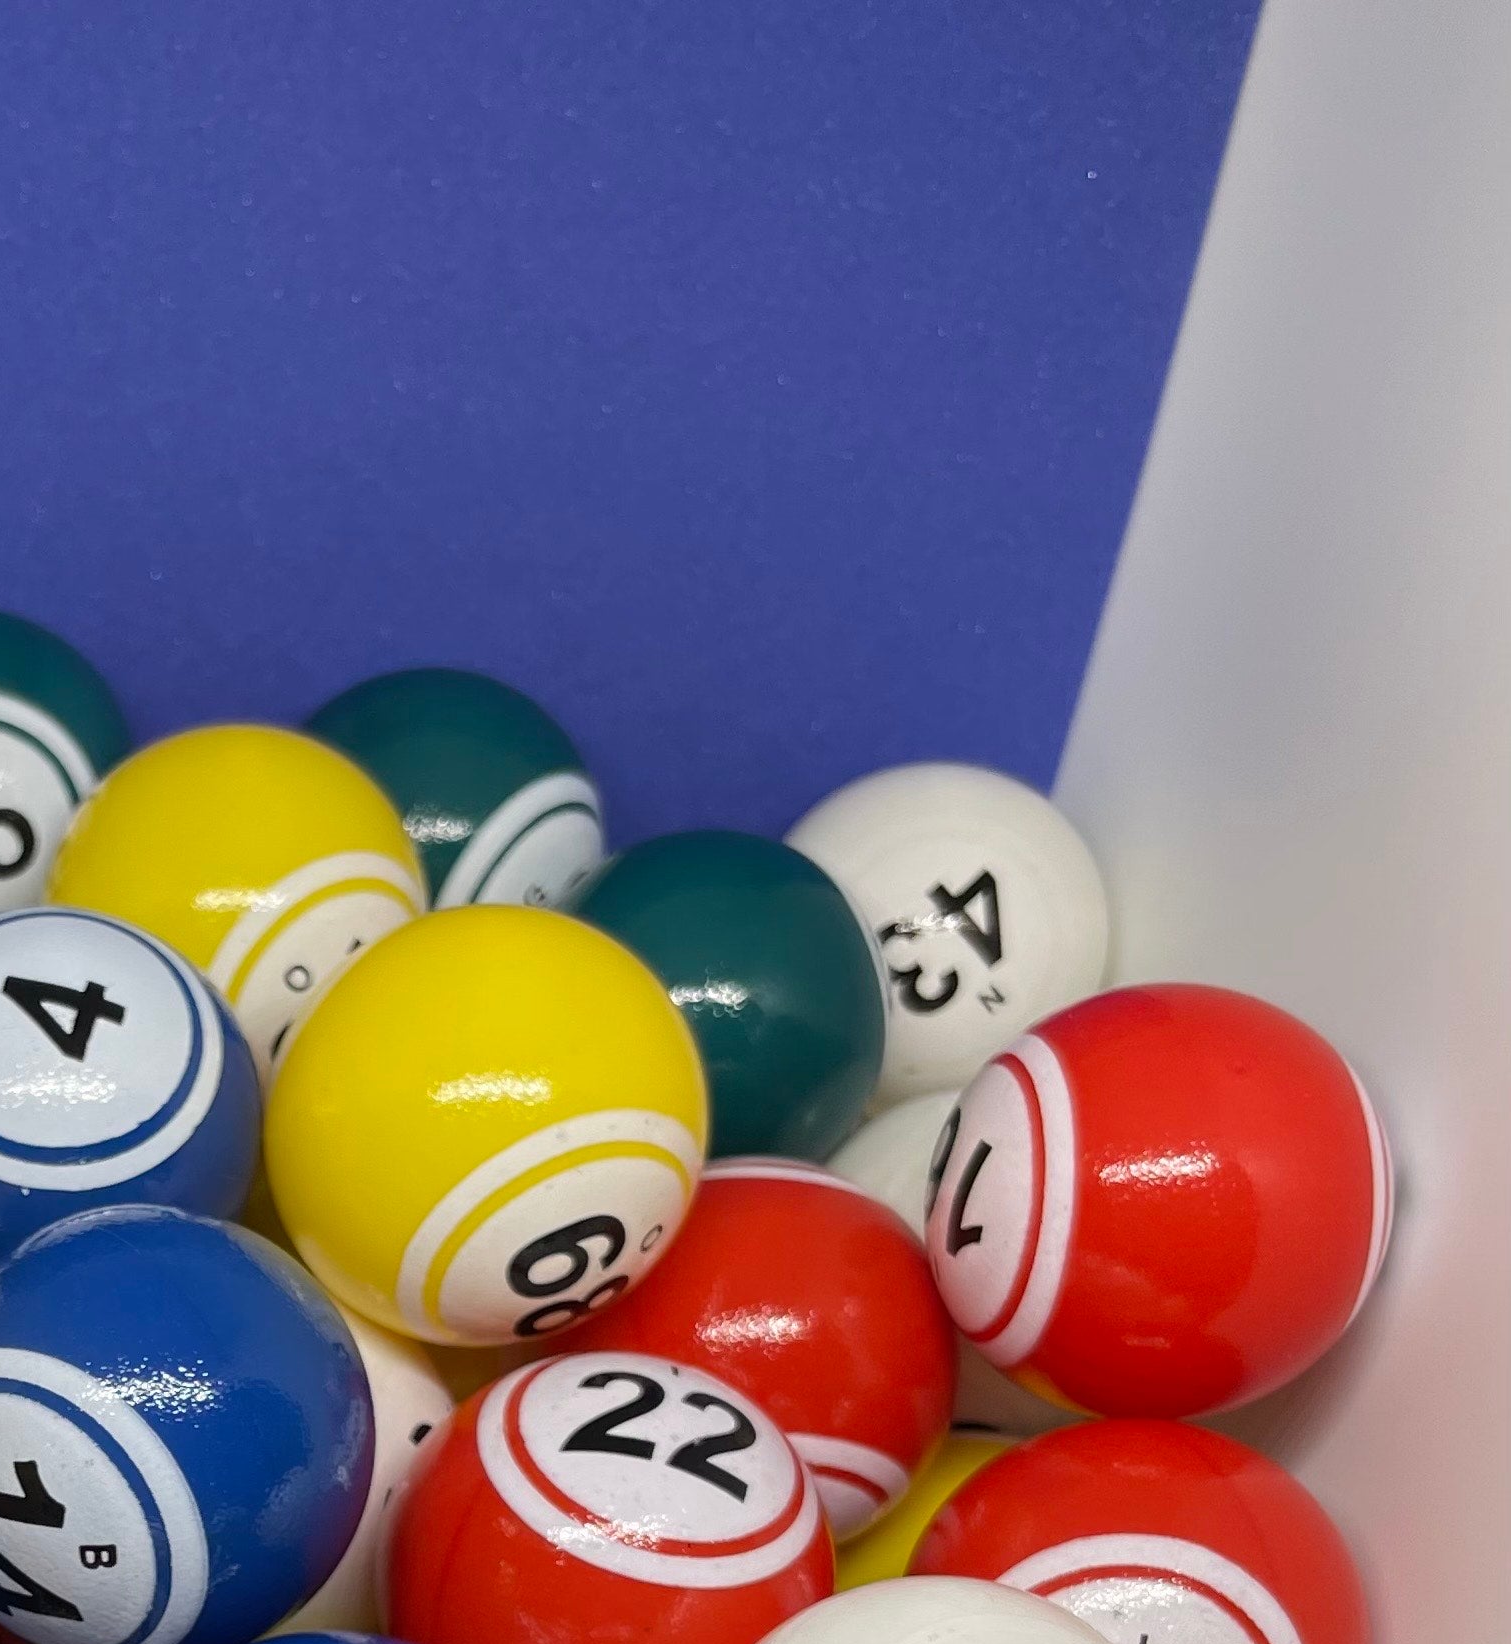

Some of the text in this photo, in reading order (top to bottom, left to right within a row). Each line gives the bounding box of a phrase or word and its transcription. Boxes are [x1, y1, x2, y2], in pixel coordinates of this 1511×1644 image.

[880, 870, 1004, 1012] 43
[2, 976, 125, 1062] 4
[979, 985, 1006, 1012] N
[559, 1371, 757, 1503] 22
[79, 1544, 118, 1569] B
